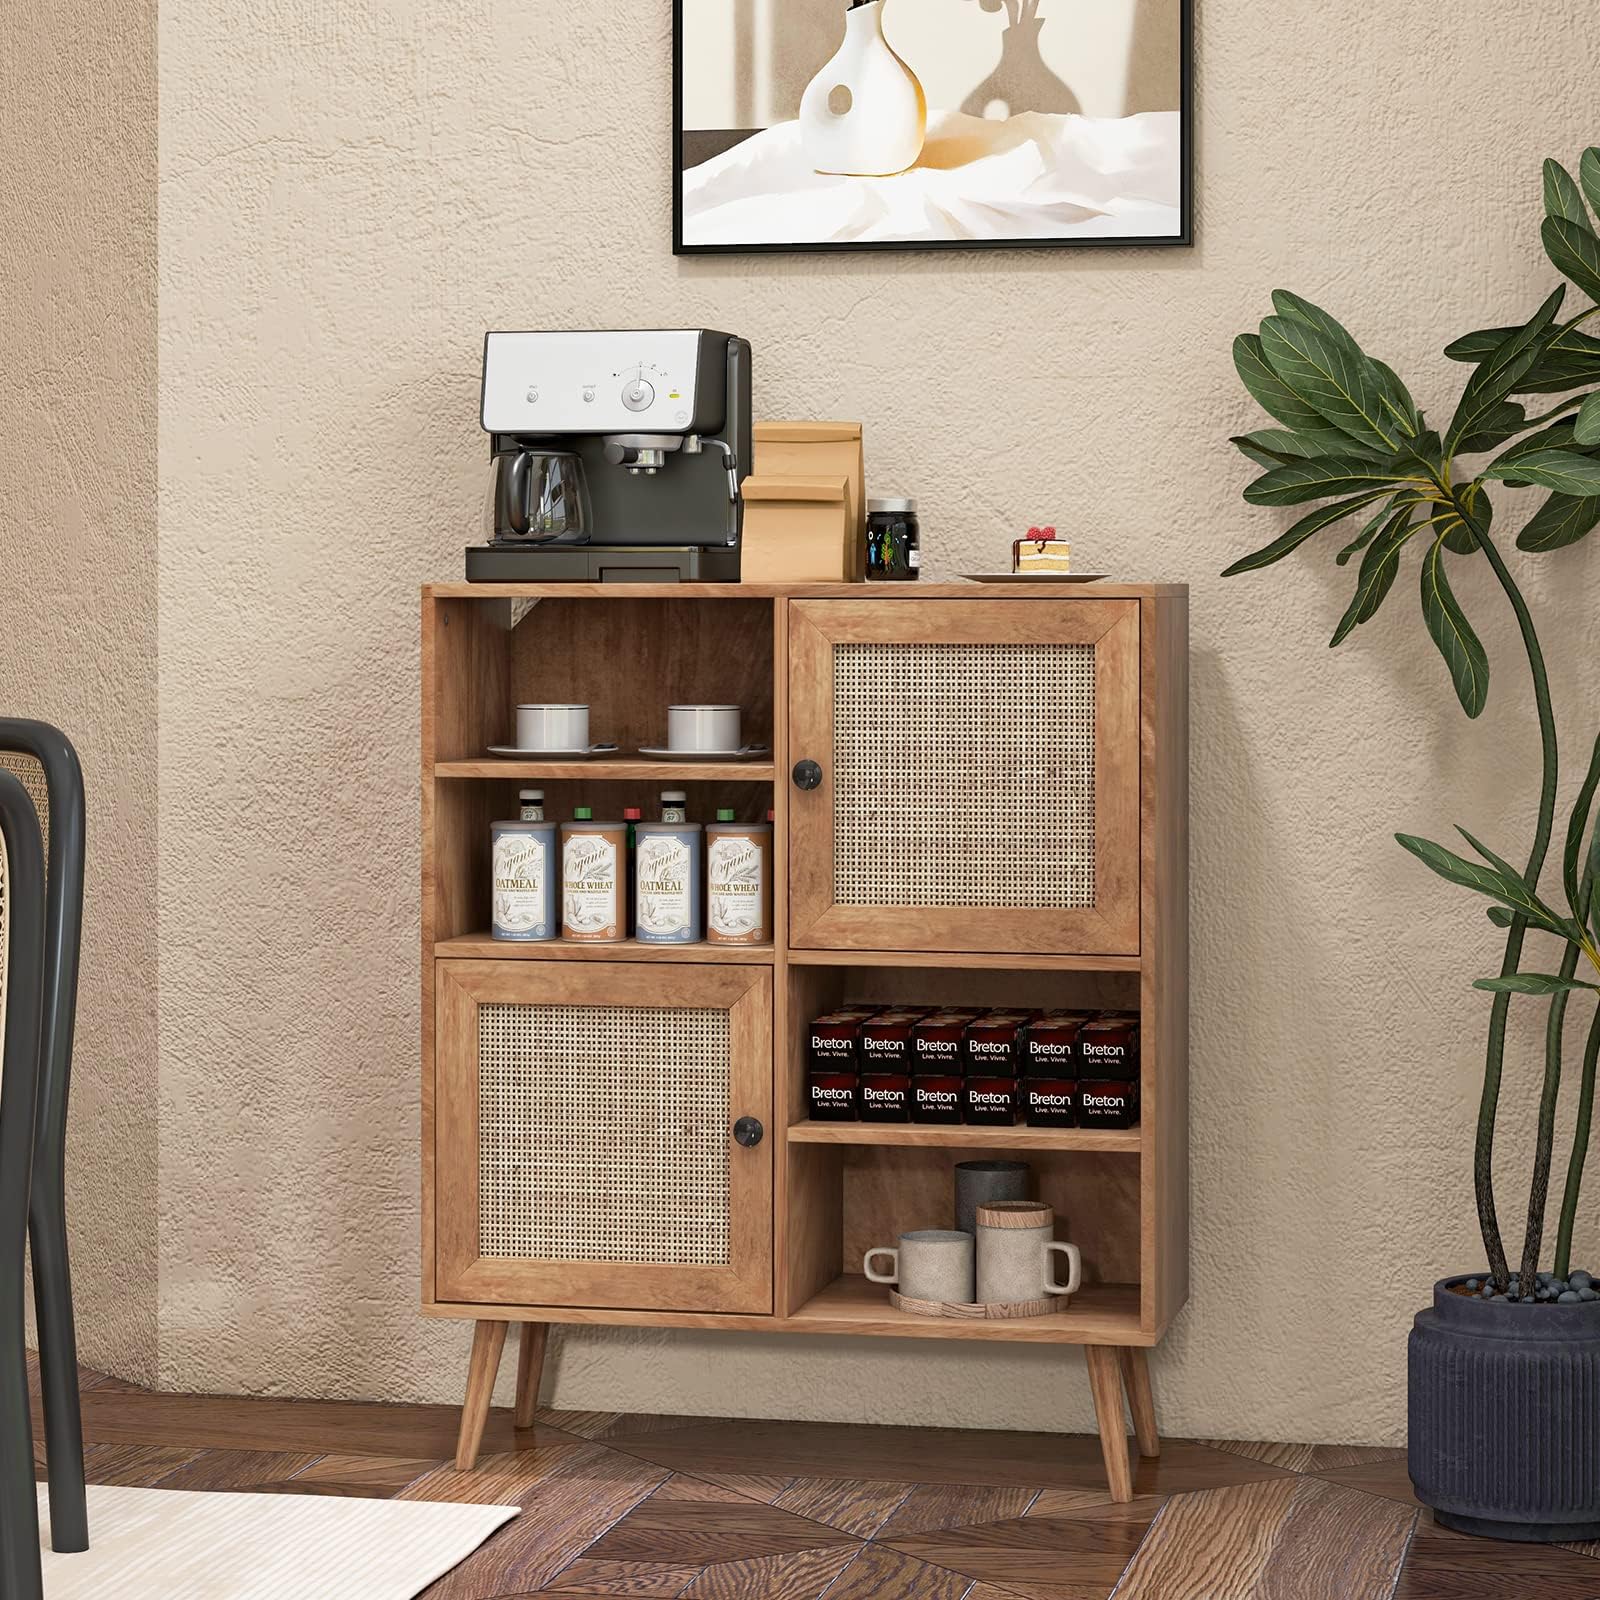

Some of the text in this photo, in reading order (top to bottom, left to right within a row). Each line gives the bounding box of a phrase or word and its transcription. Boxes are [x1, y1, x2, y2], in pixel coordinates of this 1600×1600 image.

[495, 878, 538, 889] OATMEAL
[586, 881, 613, 890] WHEAT
[640, 880, 683, 891] OATMEAL
[732, 883, 759, 892] WHEAT
[812, 1036, 852, 1049] Breton
[864, 1038, 904, 1050] Breton
[917, 1039, 957, 1052] Breton
[970, 1040, 1010, 1053] Breton
[1030, 1041, 1071, 1055] Breton
[1083, 1043, 1124, 1056] Breton
[812, 1086, 852, 1099] Breton
[864, 1088, 904, 1101] Breton
[917, 1089, 957, 1102] Breton
[970, 1090, 1010, 1104] Breton
[1030, 1092, 1071, 1105] Breton
[1083, 1094, 1124, 1107] Breton
